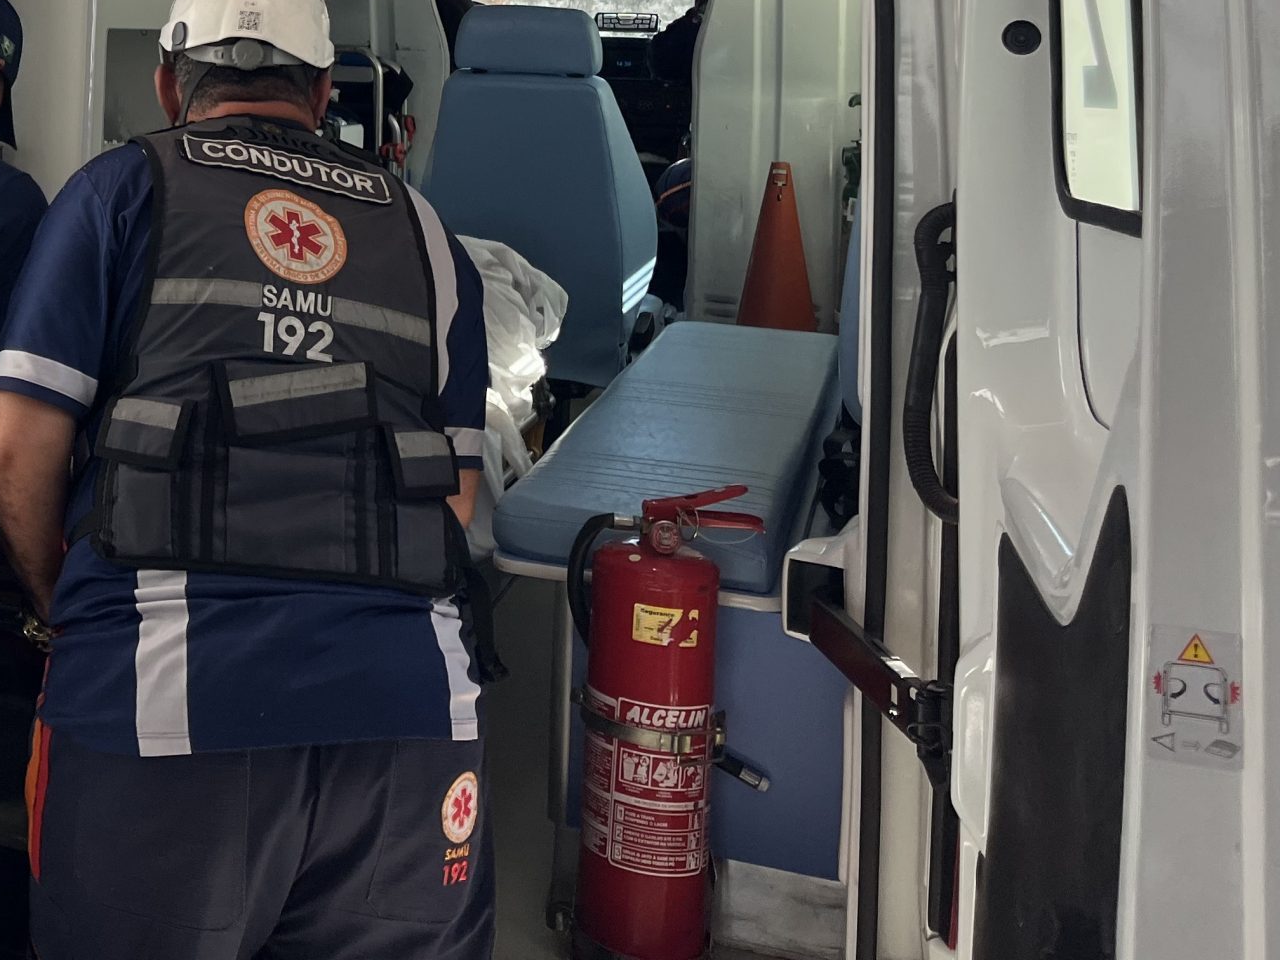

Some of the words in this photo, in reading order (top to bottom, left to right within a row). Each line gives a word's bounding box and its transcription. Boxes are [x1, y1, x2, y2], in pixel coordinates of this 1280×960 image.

[202, 142, 376, 193] CONDUTOR
[262, 284, 333, 317] SAMU
[257, 311, 335, 364] 192
[625, 705, 706, 729] ALCELIN
[444, 843, 470, 861] SAMU
[443, 861, 468, 887] 192
